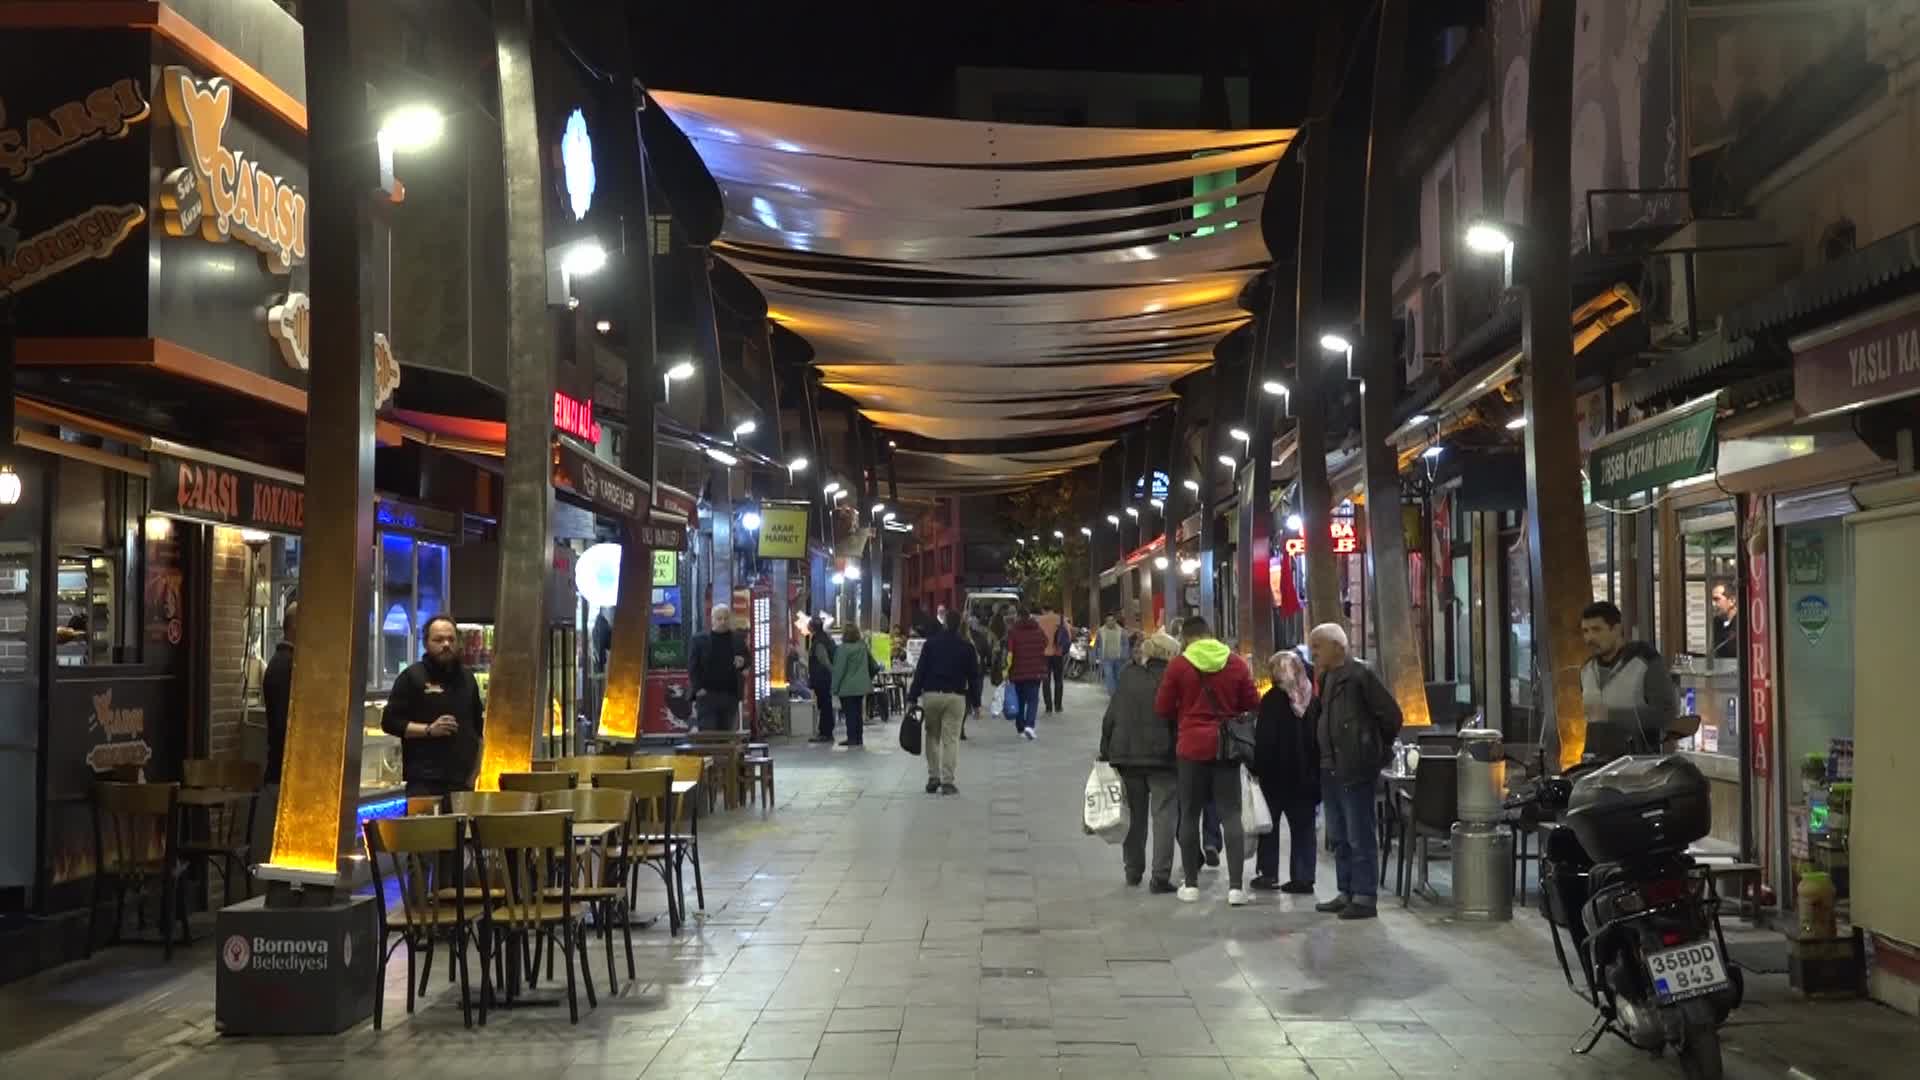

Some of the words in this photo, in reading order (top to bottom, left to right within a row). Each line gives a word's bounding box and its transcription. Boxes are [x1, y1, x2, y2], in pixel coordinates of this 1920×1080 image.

[210, 146, 306, 266] ÇARŞI
[177, 463, 238, 521] ÇARŞI
[253, 937, 328, 953] Bornova
[253, 955, 328, 974] Belediyesi
[1652, 945, 1714, 973] 35BDD
[1676, 964, 1714, 988] 843
